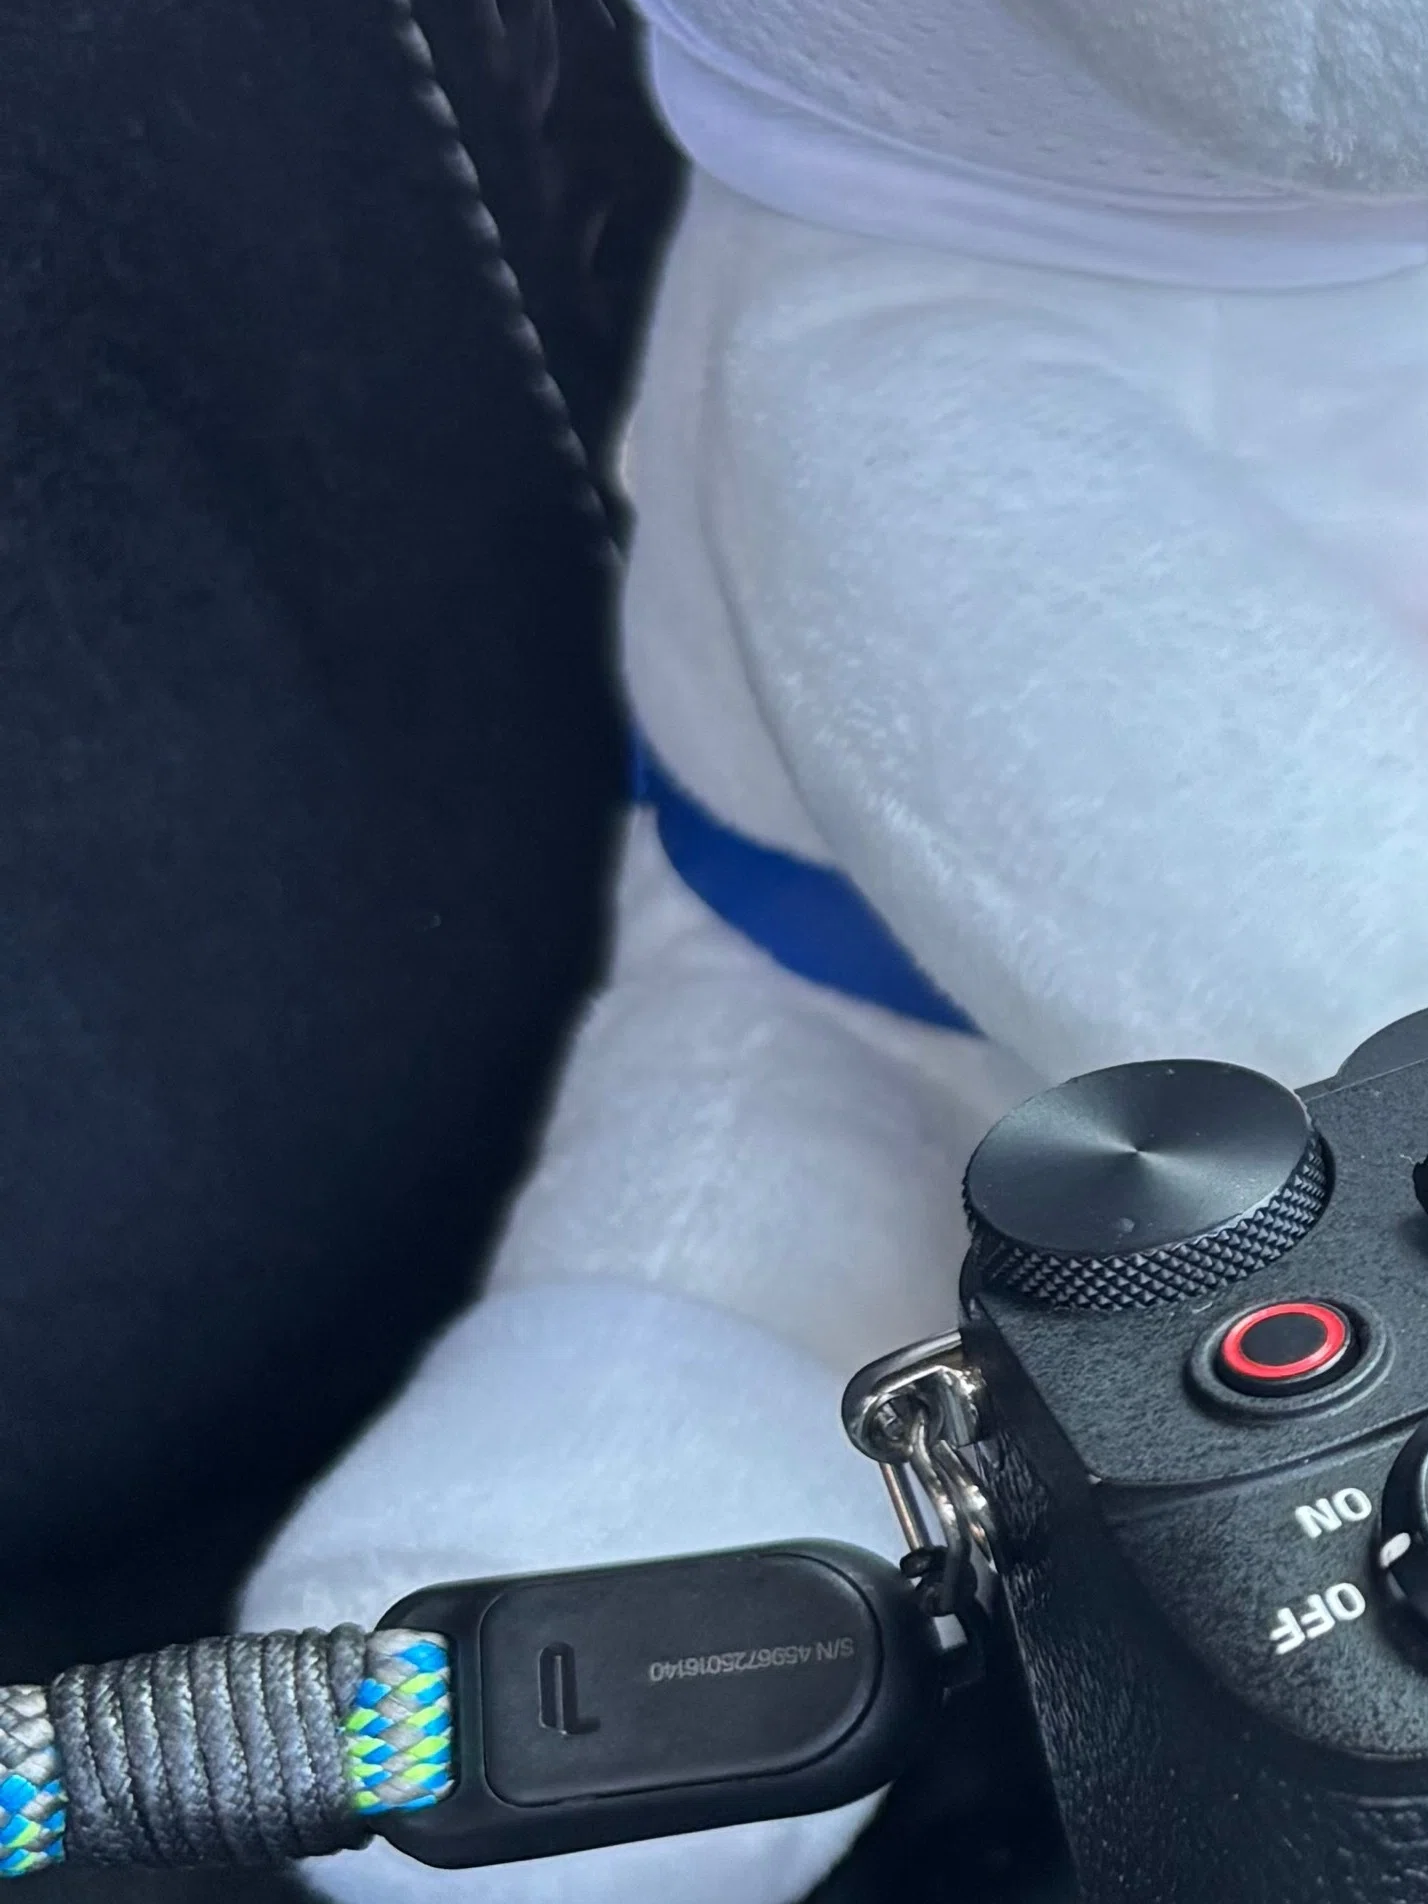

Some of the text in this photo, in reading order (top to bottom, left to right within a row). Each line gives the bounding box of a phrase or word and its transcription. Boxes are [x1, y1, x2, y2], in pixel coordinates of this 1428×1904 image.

[1294, 1487, 1372, 1539] ON
[1270, 1583, 1365, 1654] OFF
[816, 1637, 855, 1662] S/N
